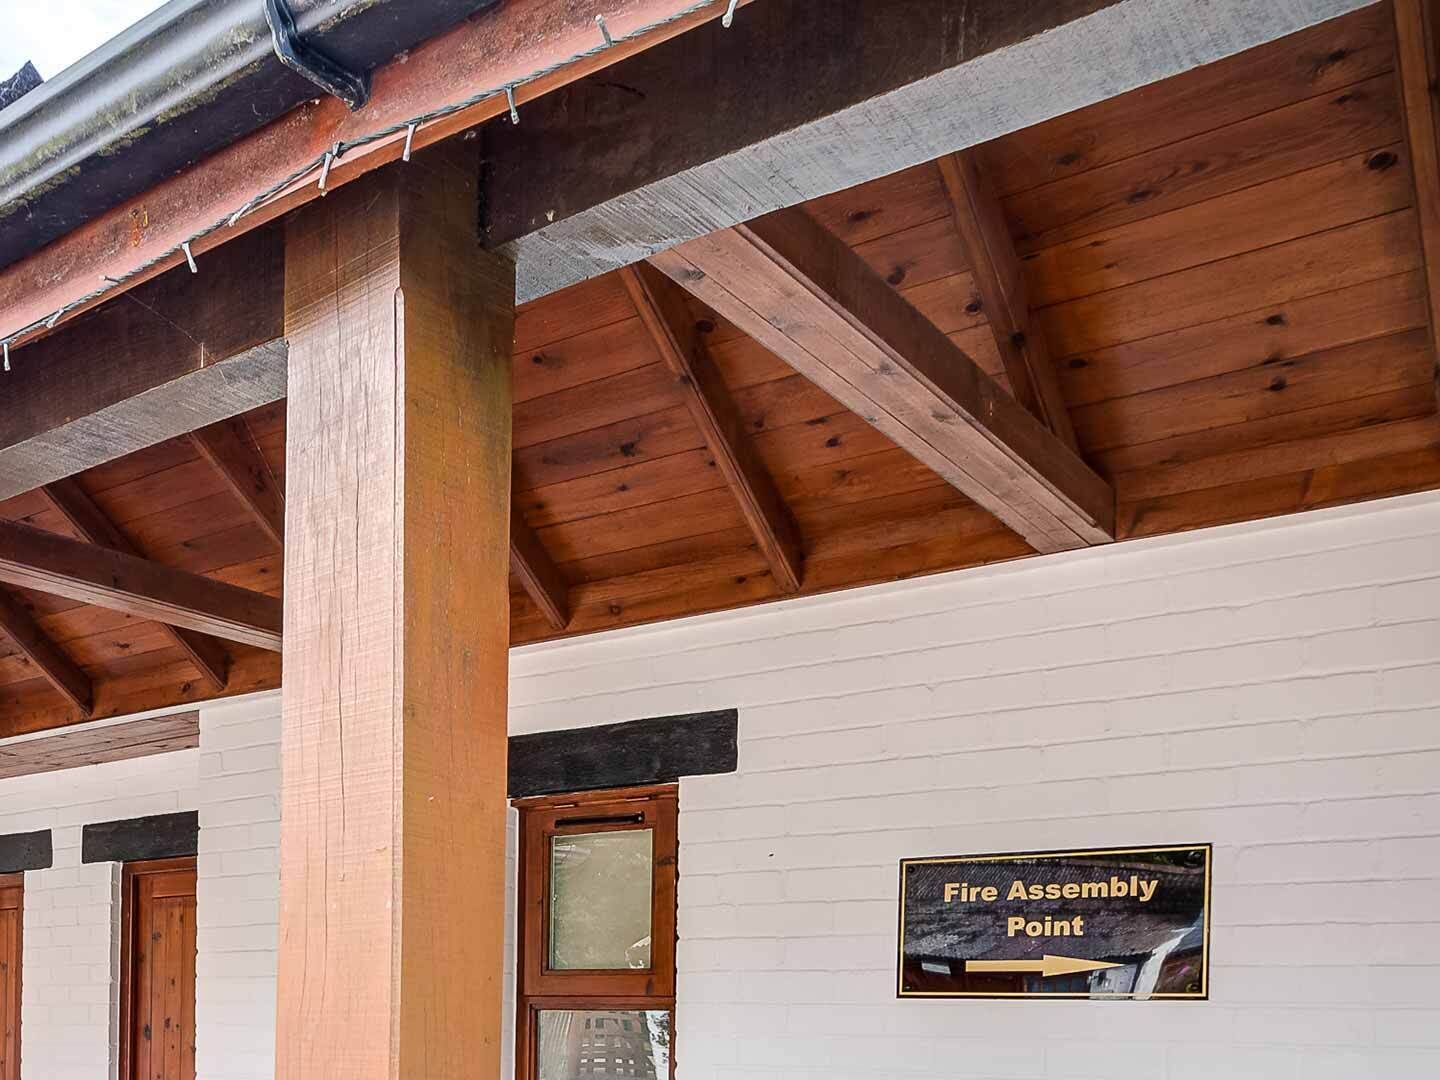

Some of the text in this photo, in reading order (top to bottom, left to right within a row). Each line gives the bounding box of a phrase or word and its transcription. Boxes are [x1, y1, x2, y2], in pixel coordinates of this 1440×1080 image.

[944, 876, 1159, 903] Fire Assembly
[1007, 916, 1084, 937] Point
